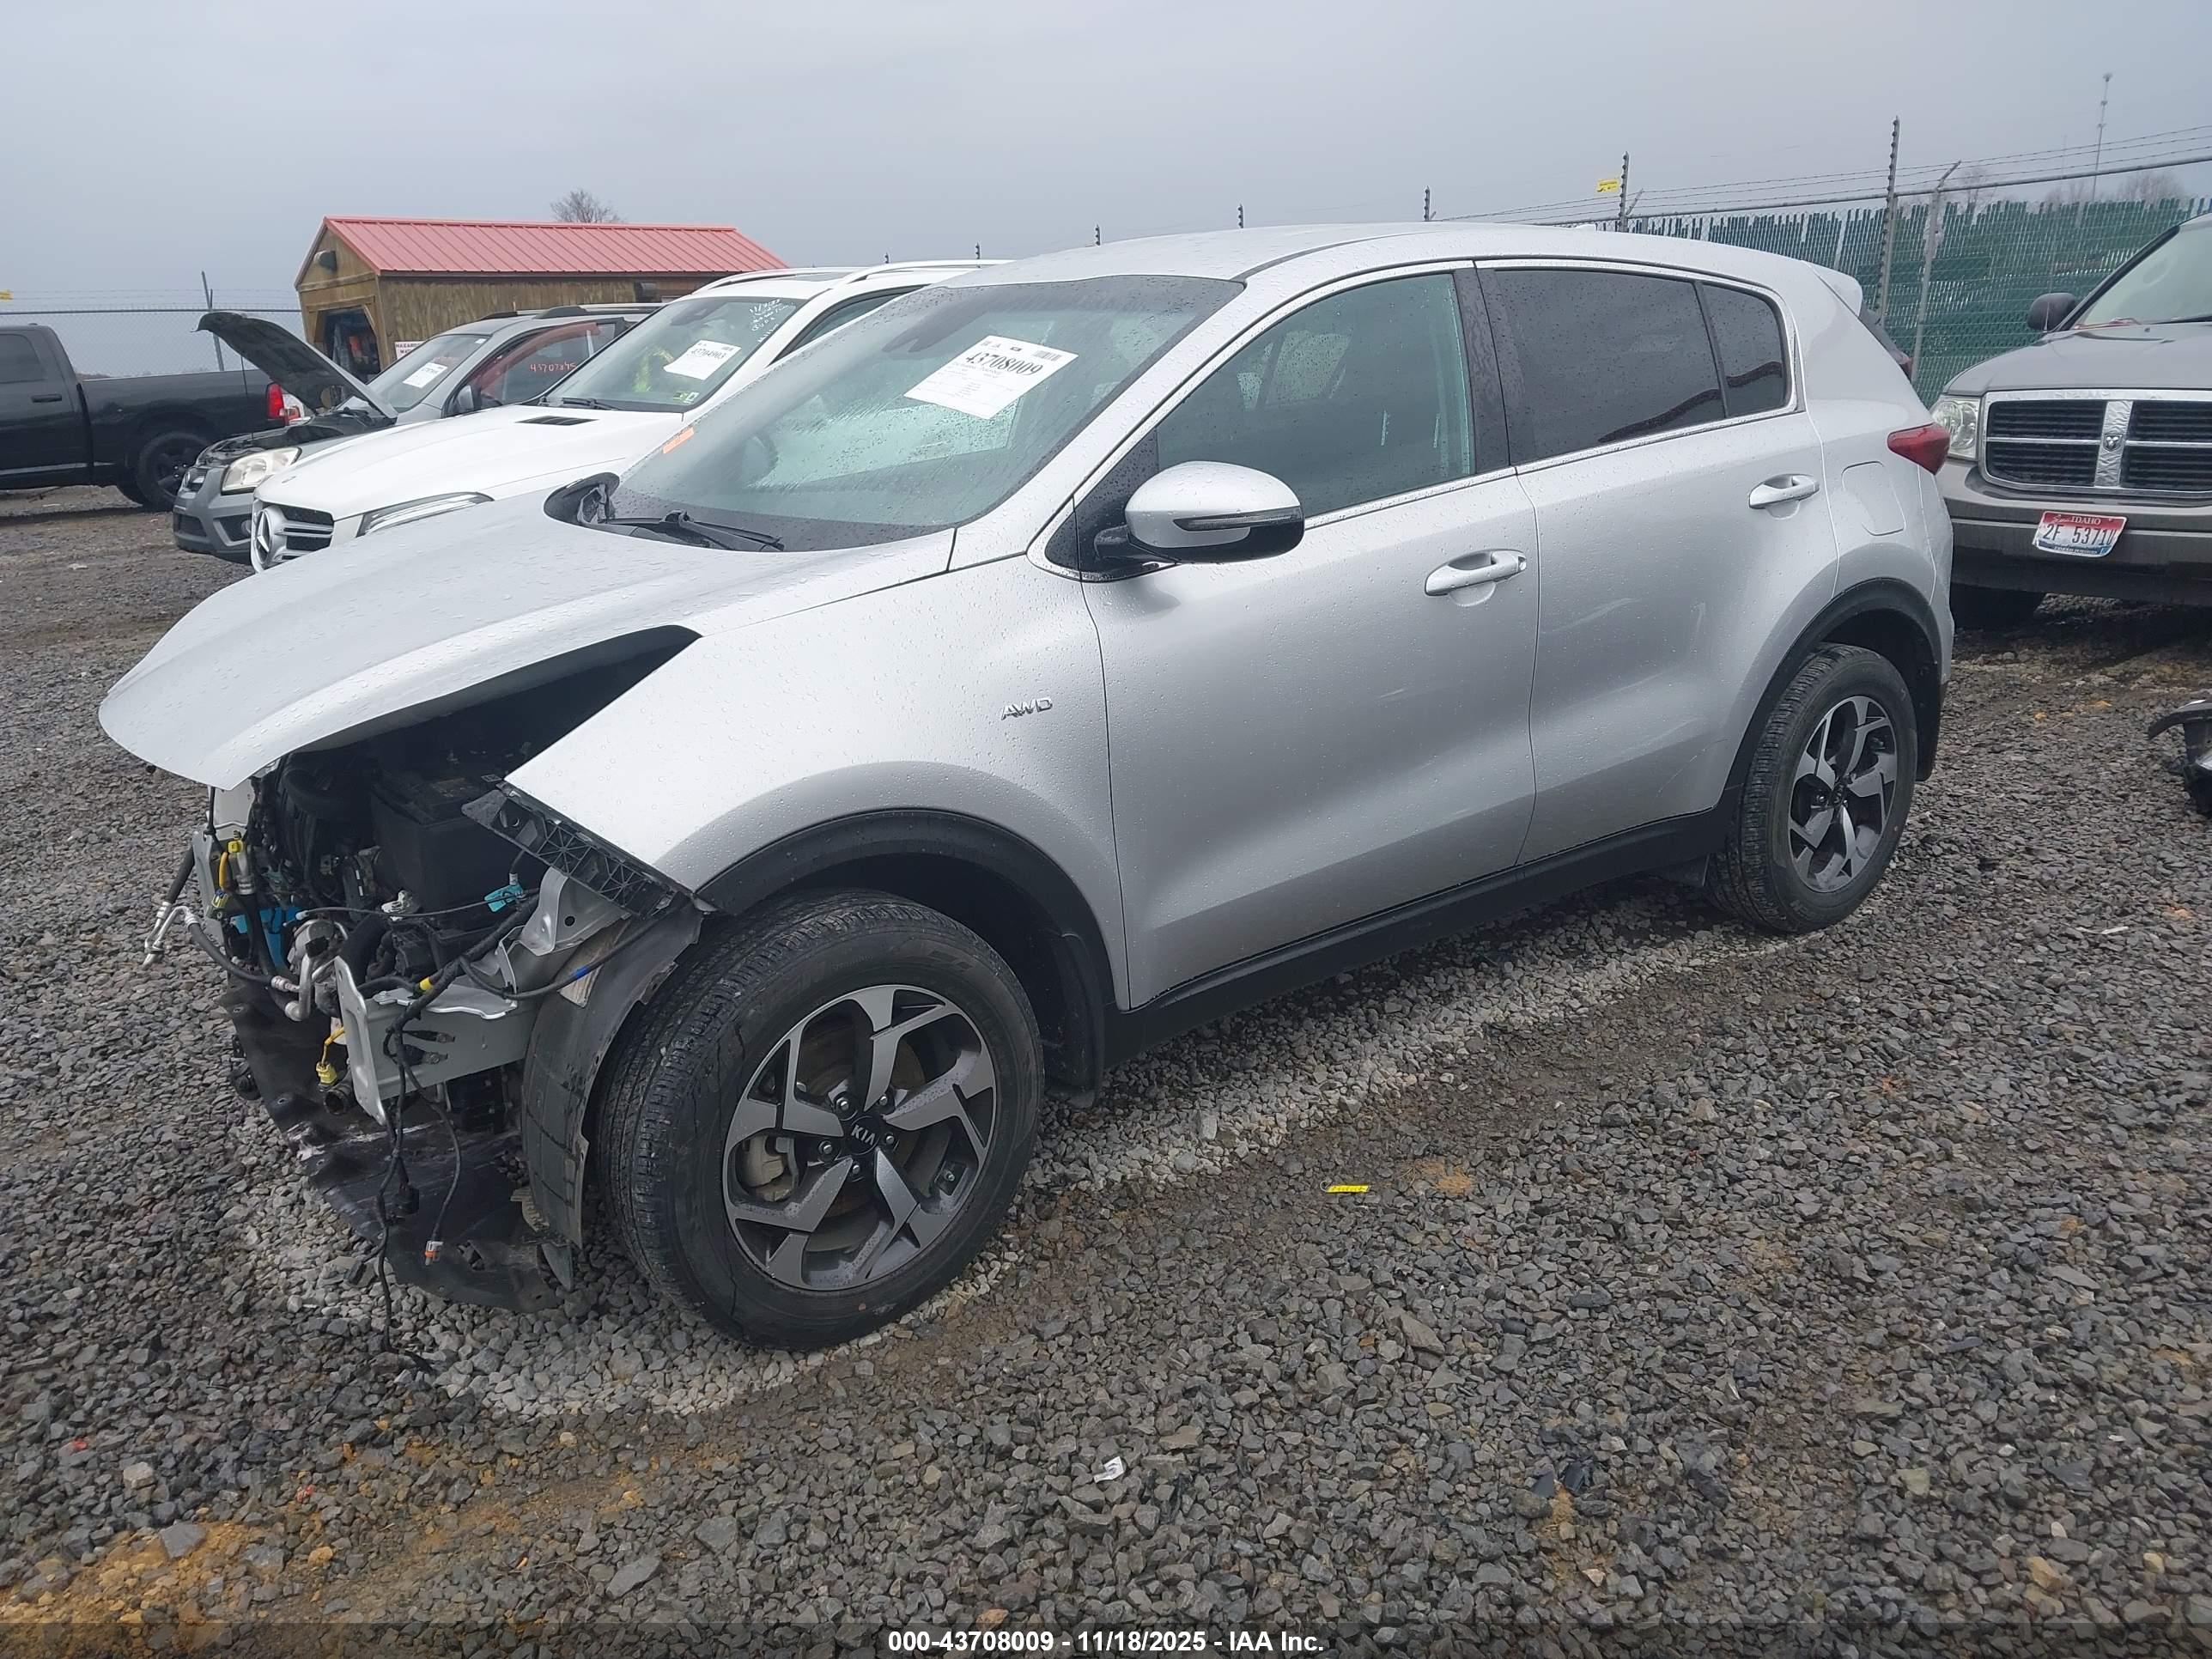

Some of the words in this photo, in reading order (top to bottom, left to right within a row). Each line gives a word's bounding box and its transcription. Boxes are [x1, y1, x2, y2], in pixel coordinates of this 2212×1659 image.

[965, 351, 1044, 376] 43708009
[2071, 515, 2101, 526] IDAHO
[2042, 523, 2064, 541] 2F
[1000, 697, 1053, 721] AWD
[851, 1124, 876, 1146] KIA
